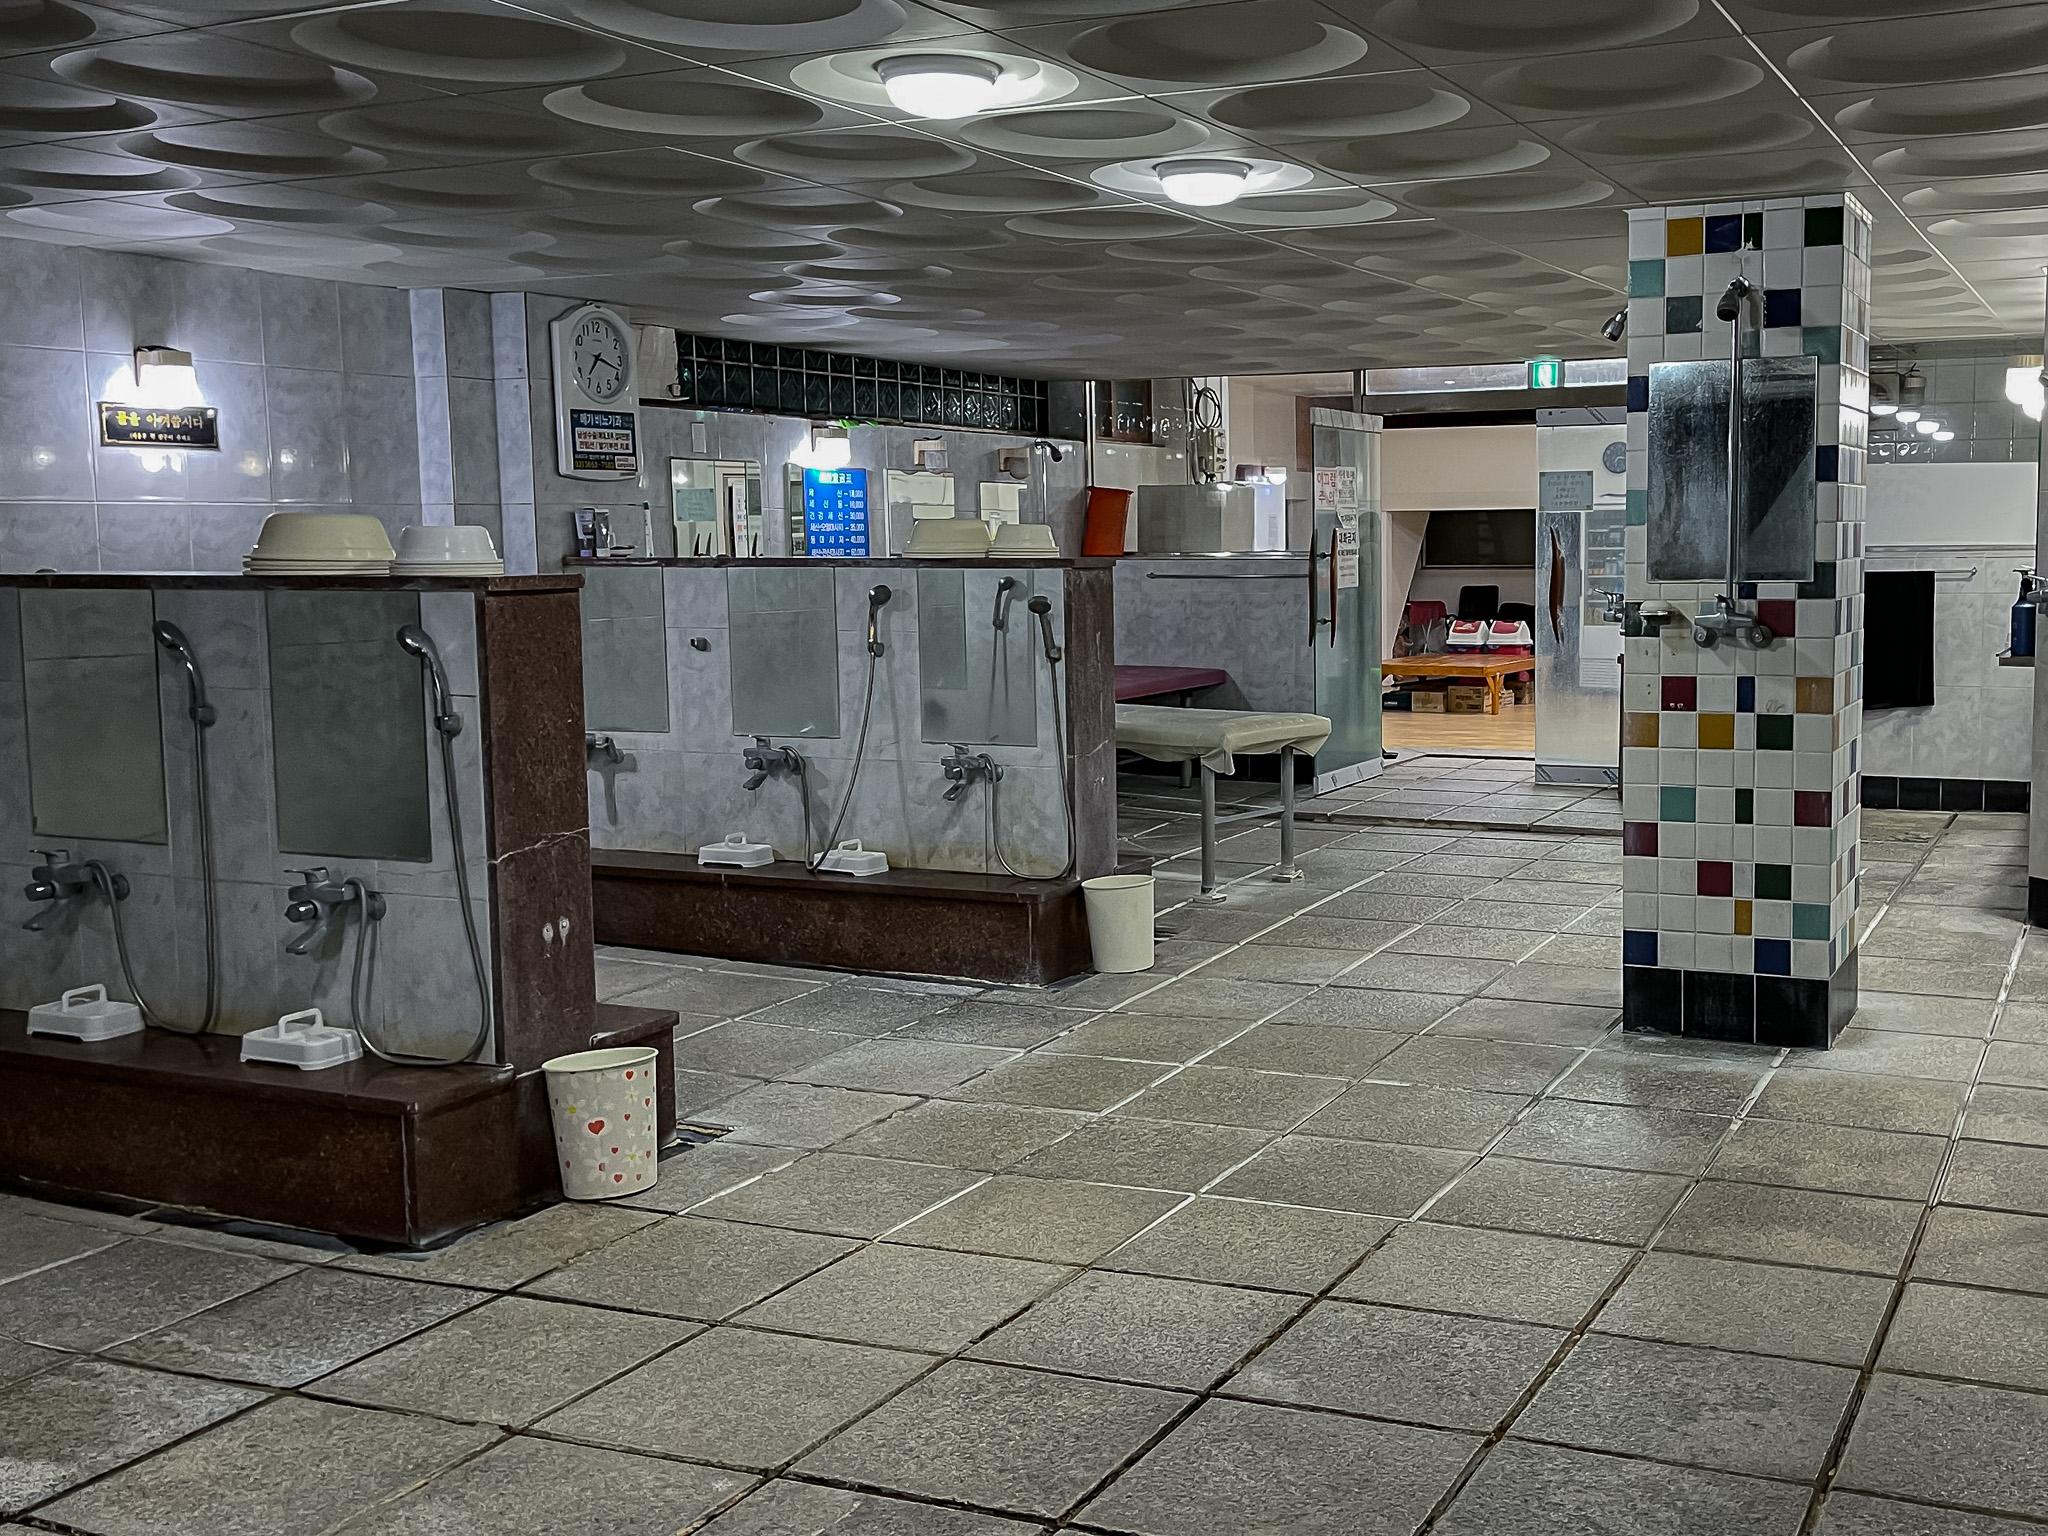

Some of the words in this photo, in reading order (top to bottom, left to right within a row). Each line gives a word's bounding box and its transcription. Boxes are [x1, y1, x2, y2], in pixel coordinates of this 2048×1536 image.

[582, 324, 589, 336] 11
[591, 321, 600, 333] 12
[605, 327, 608, 339] 1
[612, 338, 619, 350] 2
[617, 355, 622, 367] 3
[615, 371, 620, 382] 4
[587, 377, 591, 389] 7
[596, 382, 602, 394] 6
[606, 379, 612, 391] 5
